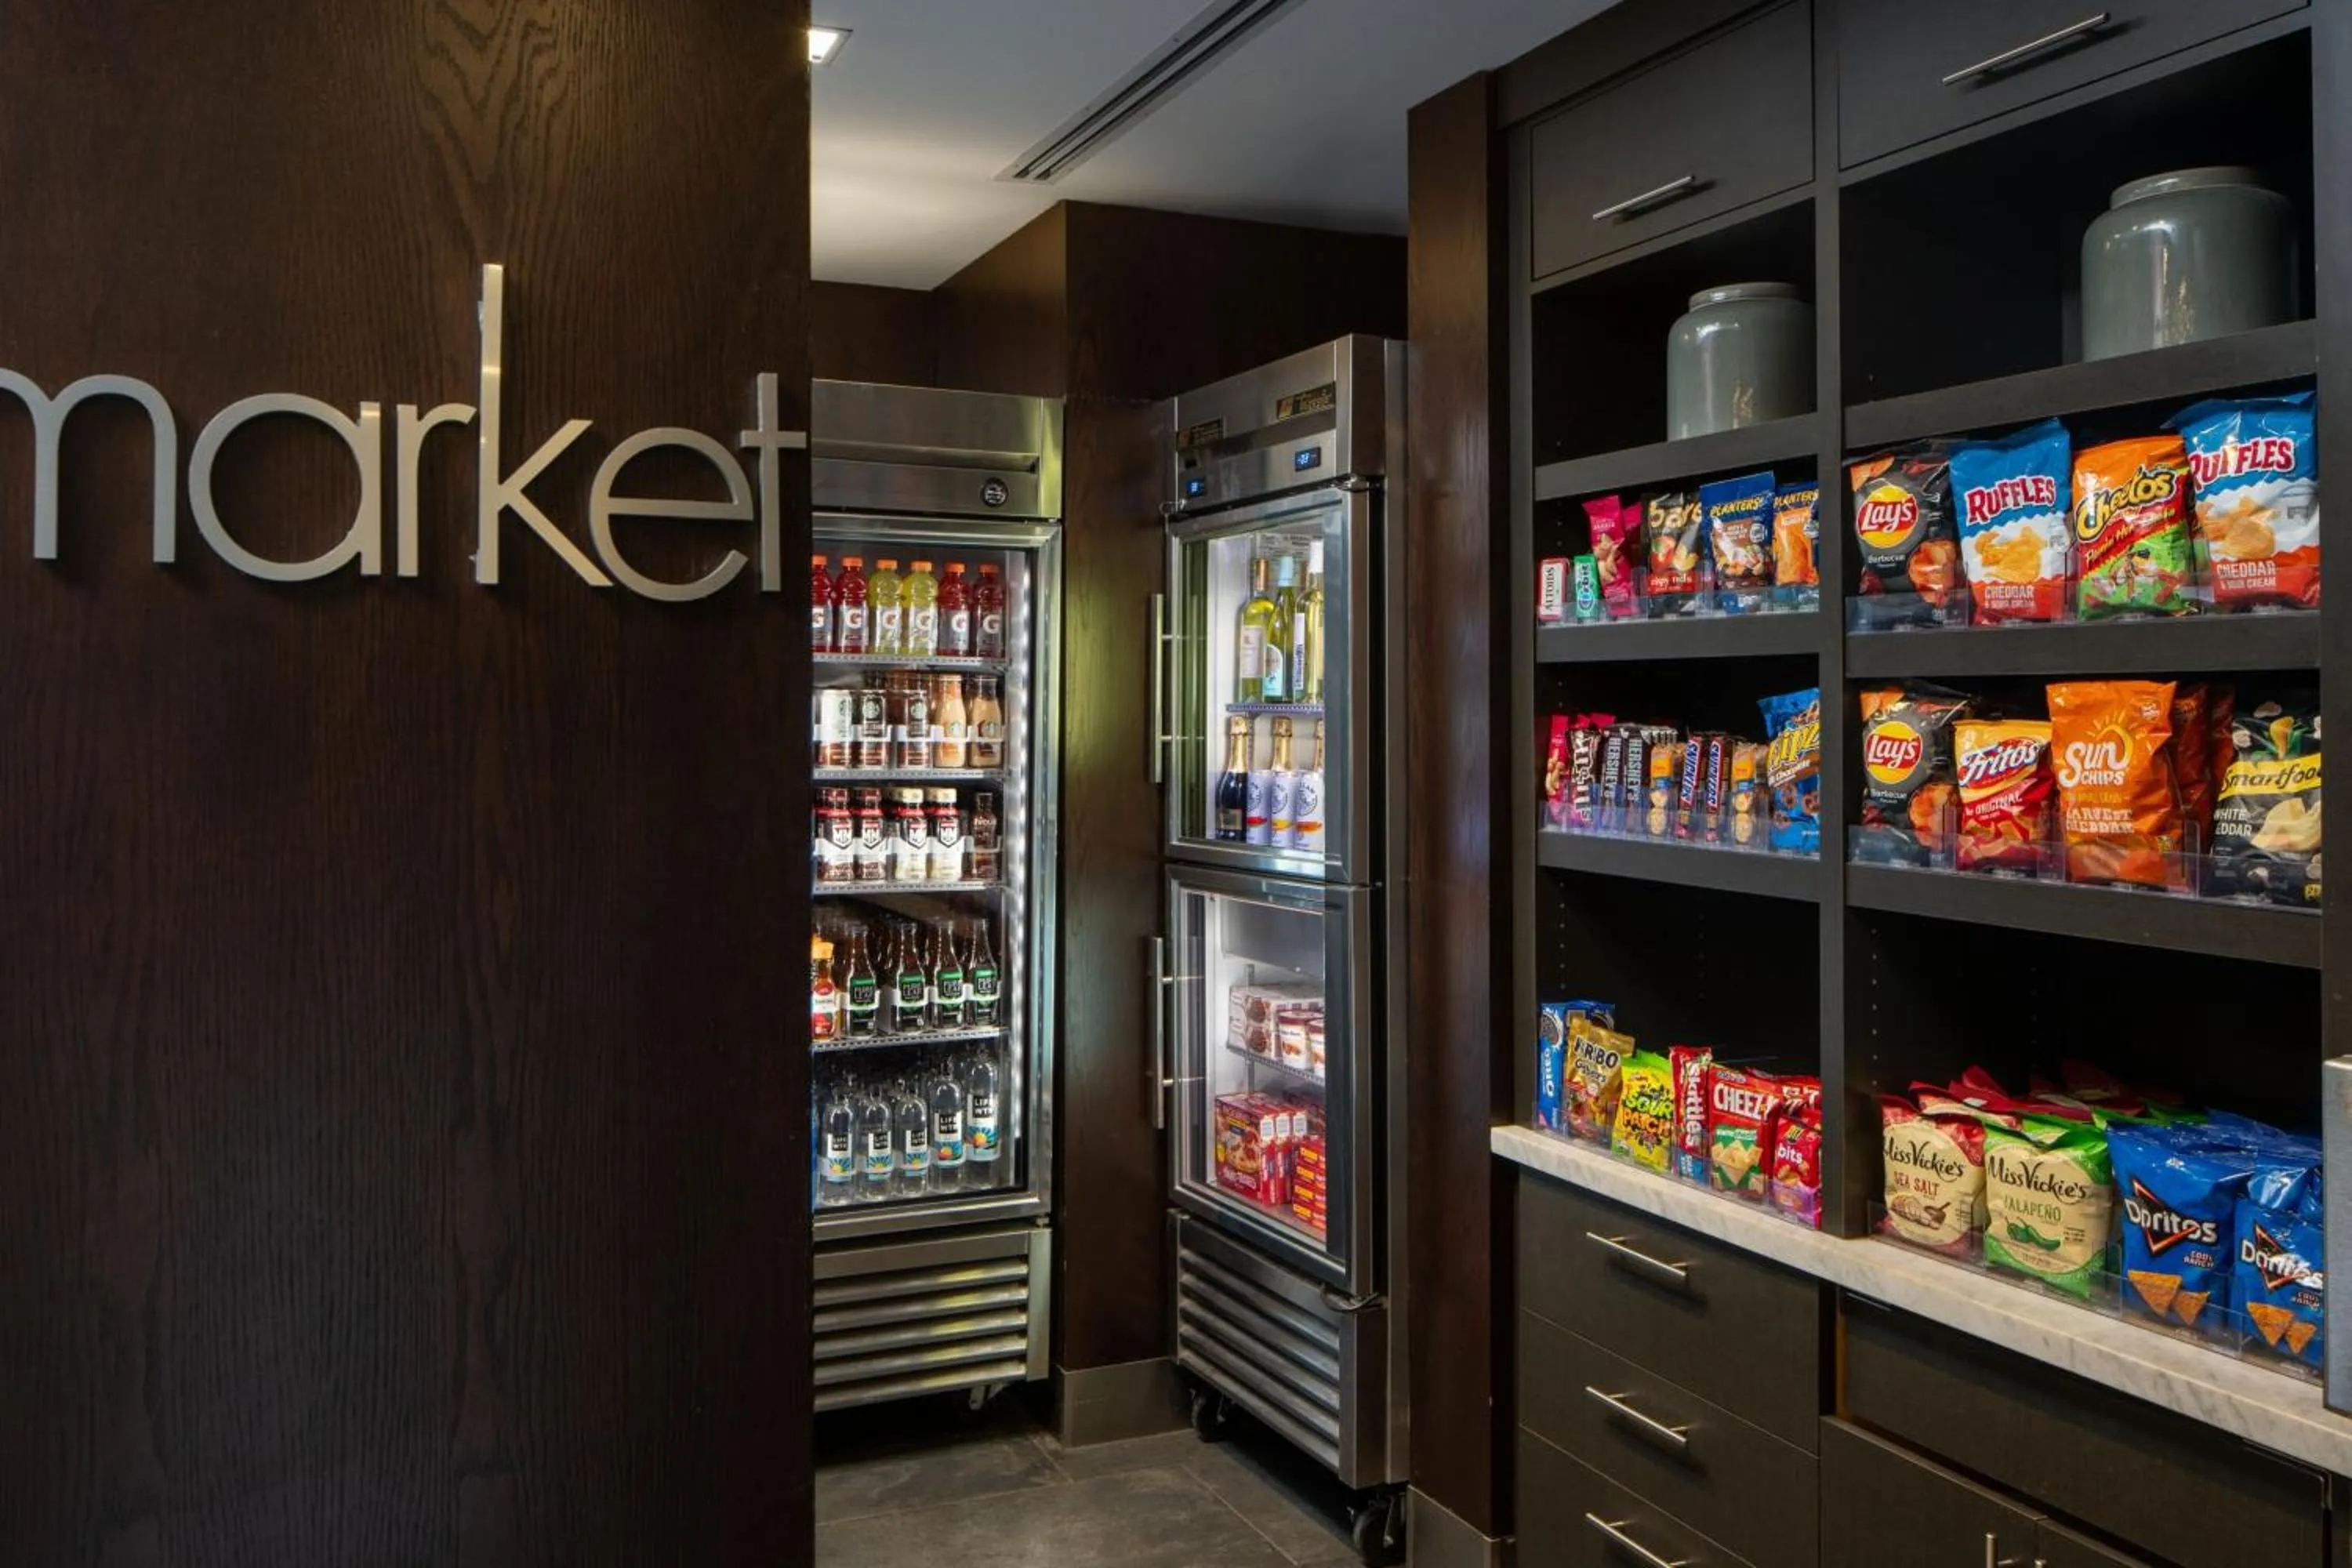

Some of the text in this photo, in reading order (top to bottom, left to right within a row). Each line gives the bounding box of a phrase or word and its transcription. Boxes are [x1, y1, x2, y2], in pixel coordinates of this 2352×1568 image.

[0, 263, 807, 602] market
[1710, 496, 1762, 517] PLANTERS
[1860, 499, 1914, 534] Lay's
[1965, 475, 2056, 527] RUFFLES
[2075, 464, 2177, 543] Cheetos
[2216, 561, 2276, 579] CHEDDAR
[1984, 585, 2034, 600] CHEDDAR
[1867, 733, 1918, 769] Lay's
[1958, 742, 2041, 787] Fritos
[2081, 770, 2125, 786] CHIPS
[2214, 808, 2249, 822] WHITE
[2215, 822, 2252, 837] EDDAR
[1625, 1094, 1673, 1120] SOUR
[1686, 1063, 1706, 1147] Skittles
[1713, 1082, 1779, 1122] CHEEZ-I
[1623, 1107, 1671, 1137] PATCH
[1777, 1142, 1803, 1164] bits
[1908, 1141, 1966, 1182] Vickie's
[1914, 1177, 1940, 1196] SALT
[1987, 1155, 2024, 1188] Miss
[2020, 1161, 2086, 1205] Vickie's
[2124, 1198, 2219, 1244] Doritos
[2241, 1239, 2323, 1290] Doritos
